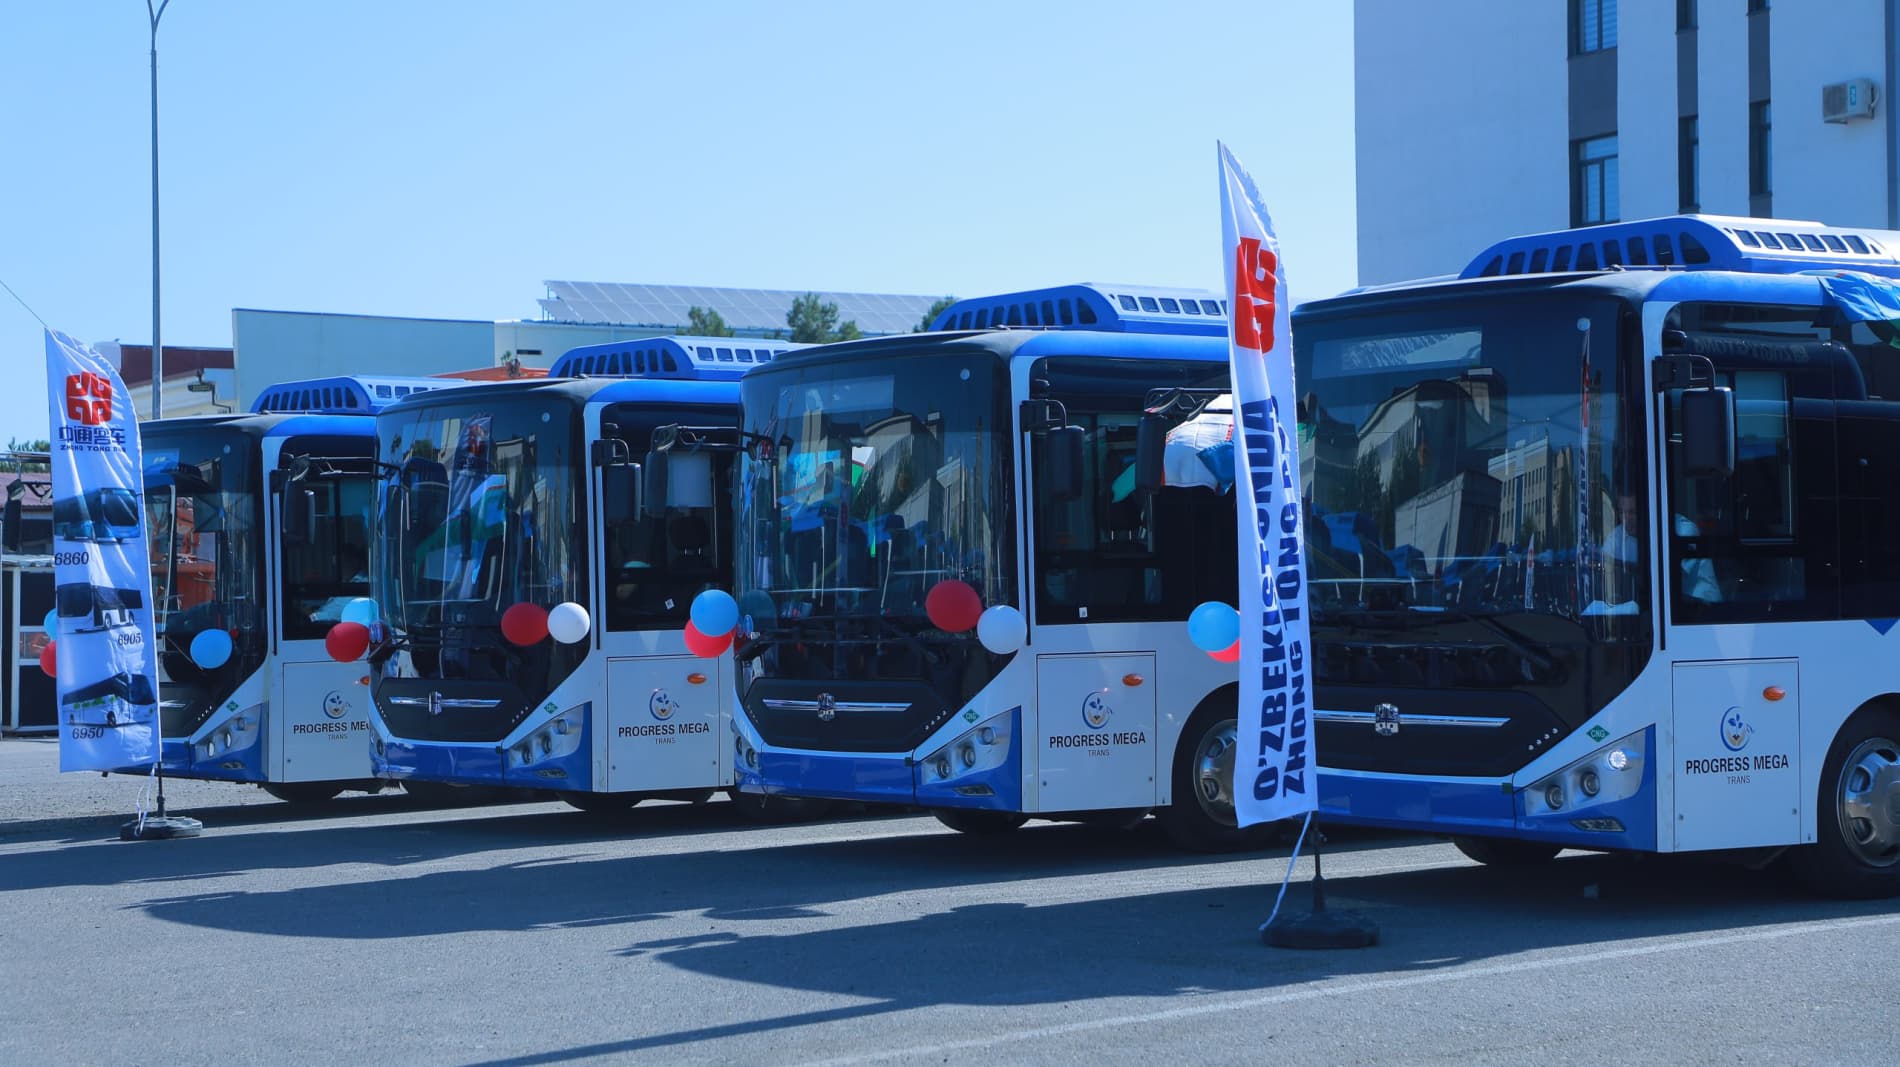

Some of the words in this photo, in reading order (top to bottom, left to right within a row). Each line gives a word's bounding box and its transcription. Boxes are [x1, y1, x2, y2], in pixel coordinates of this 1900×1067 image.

[54, 551, 90, 566] 6860
[1276, 503, 1301, 631] TONG
[117, 632, 142, 647] 6905
[1283, 640, 1307, 798] ZHONG
[72, 727, 104, 741] 6950
[293, 722, 348, 735] PROGRESS
[618, 724, 675, 738] PROGRESS
[678, 722, 710, 735] MEGA
[1590, 729, 1607, 738] CNG
[1049, 733, 1110, 749] PROGRESS
[1113, 731, 1147, 746] MEGA
[1087, 749, 1110, 758] TRANS
[1685, 758, 1751, 775] PROGRESS
[1753, 754, 1790, 771] MEGA
[1727, 775, 1751, 785] TRANS
